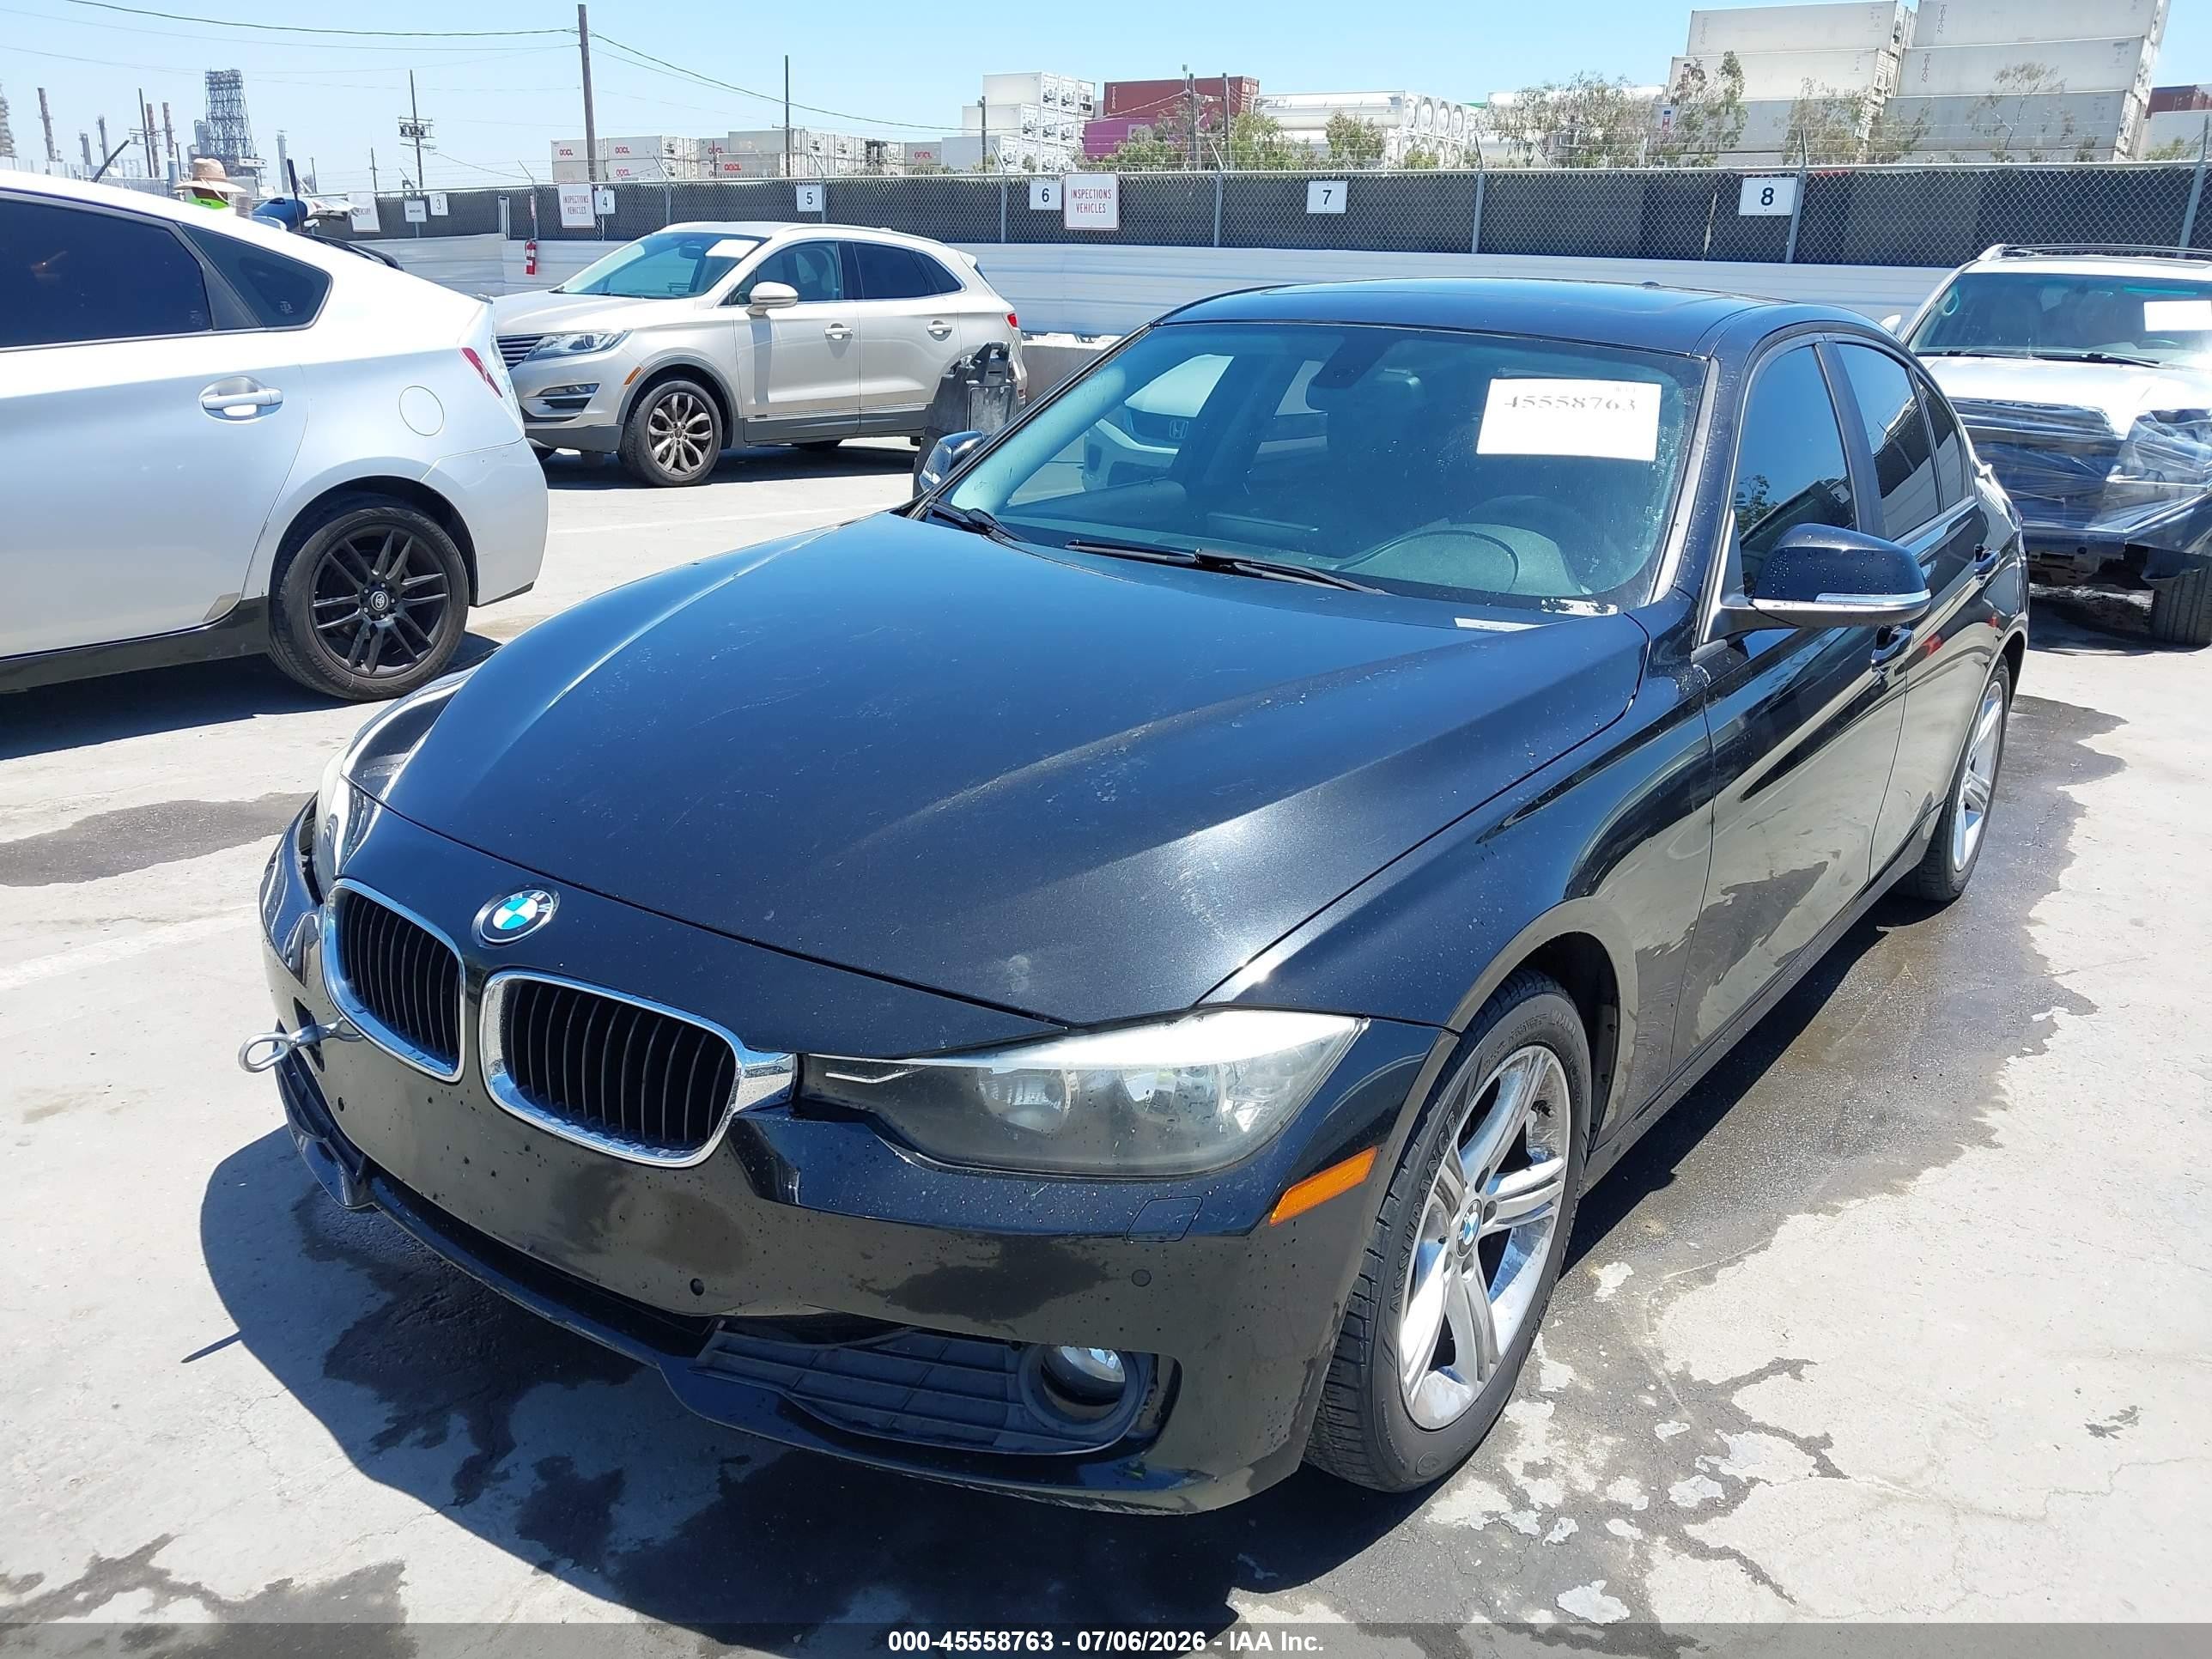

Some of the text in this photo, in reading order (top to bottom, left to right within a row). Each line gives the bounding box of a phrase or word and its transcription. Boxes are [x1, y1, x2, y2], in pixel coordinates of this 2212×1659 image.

[562, 195, 589, 204] INSPECTIONS
[806, 191, 813, 205] 5
[1042, 188, 1050, 203] 6
[1070, 189, 1112, 199] INSPECTIONS
[1322, 189, 1333, 205] 7
[1760, 187, 1774, 206] 8
[436, 198, 441, 210] 3
[602, 196, 608, 208] 4
[567, 206, 586, 215] VEHICLES
[1076, 204, 1106, 214] VEHICLES
[1504, 395, 1636, 411] 45558763
[1458, 1202, 1478, 1240] BMW
